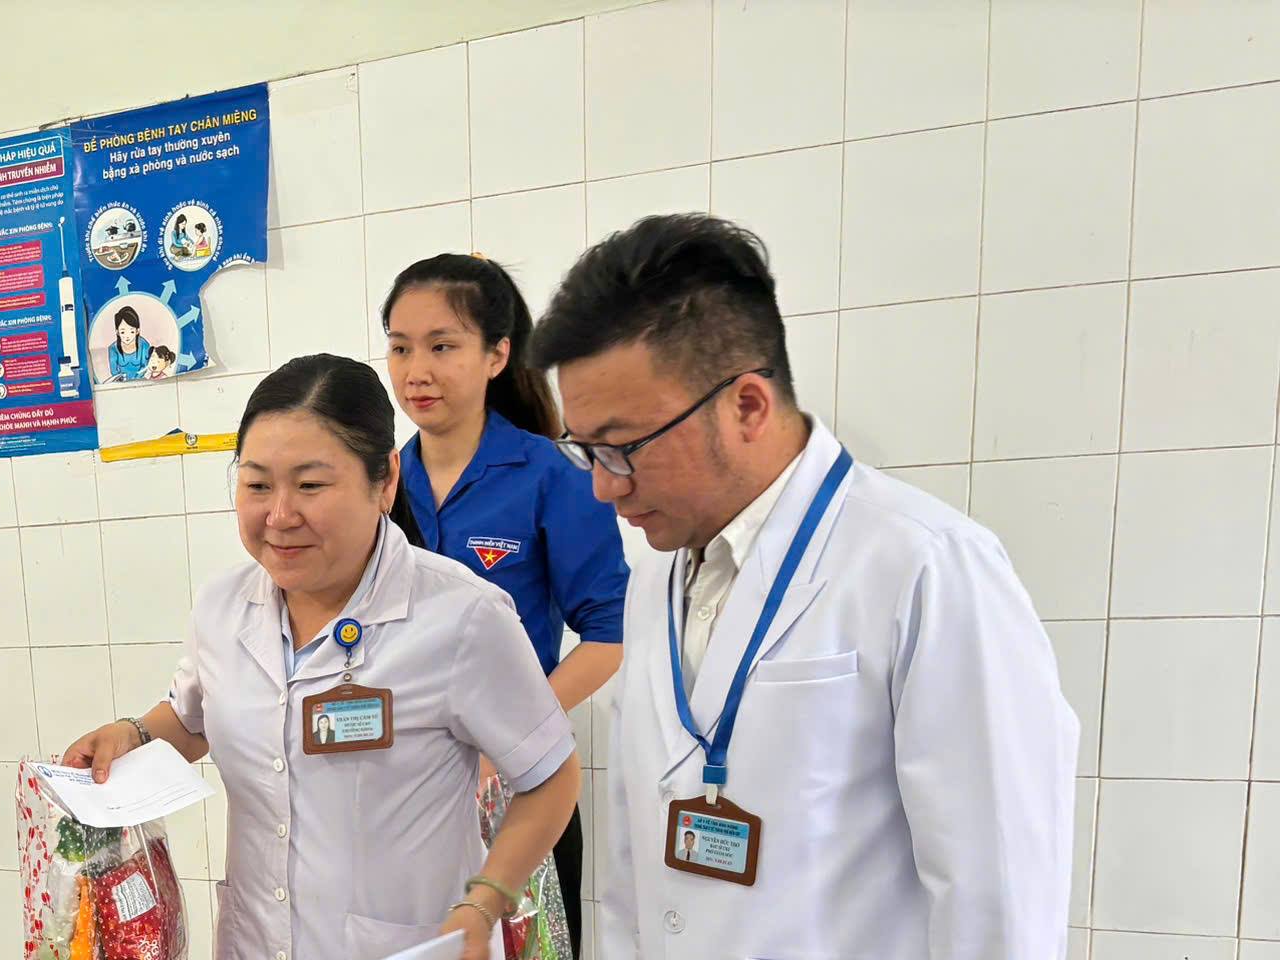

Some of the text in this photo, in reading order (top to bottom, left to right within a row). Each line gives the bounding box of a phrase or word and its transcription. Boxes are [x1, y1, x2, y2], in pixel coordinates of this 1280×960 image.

[84, 108, 257, 153] ĐỂ PHÒNG BỆNH TAY CHÂN MIỆNG
[110, 150, 128, 164] Hãy
[148, 145, 162, 157] tay
[164, 137, 199, 153] thường
[201, 131, 231, 147] xuyên
[129, 162, 140, 174] xà
[176, 153, 187, 166] và
[216, 144, 240, 160] sạch
